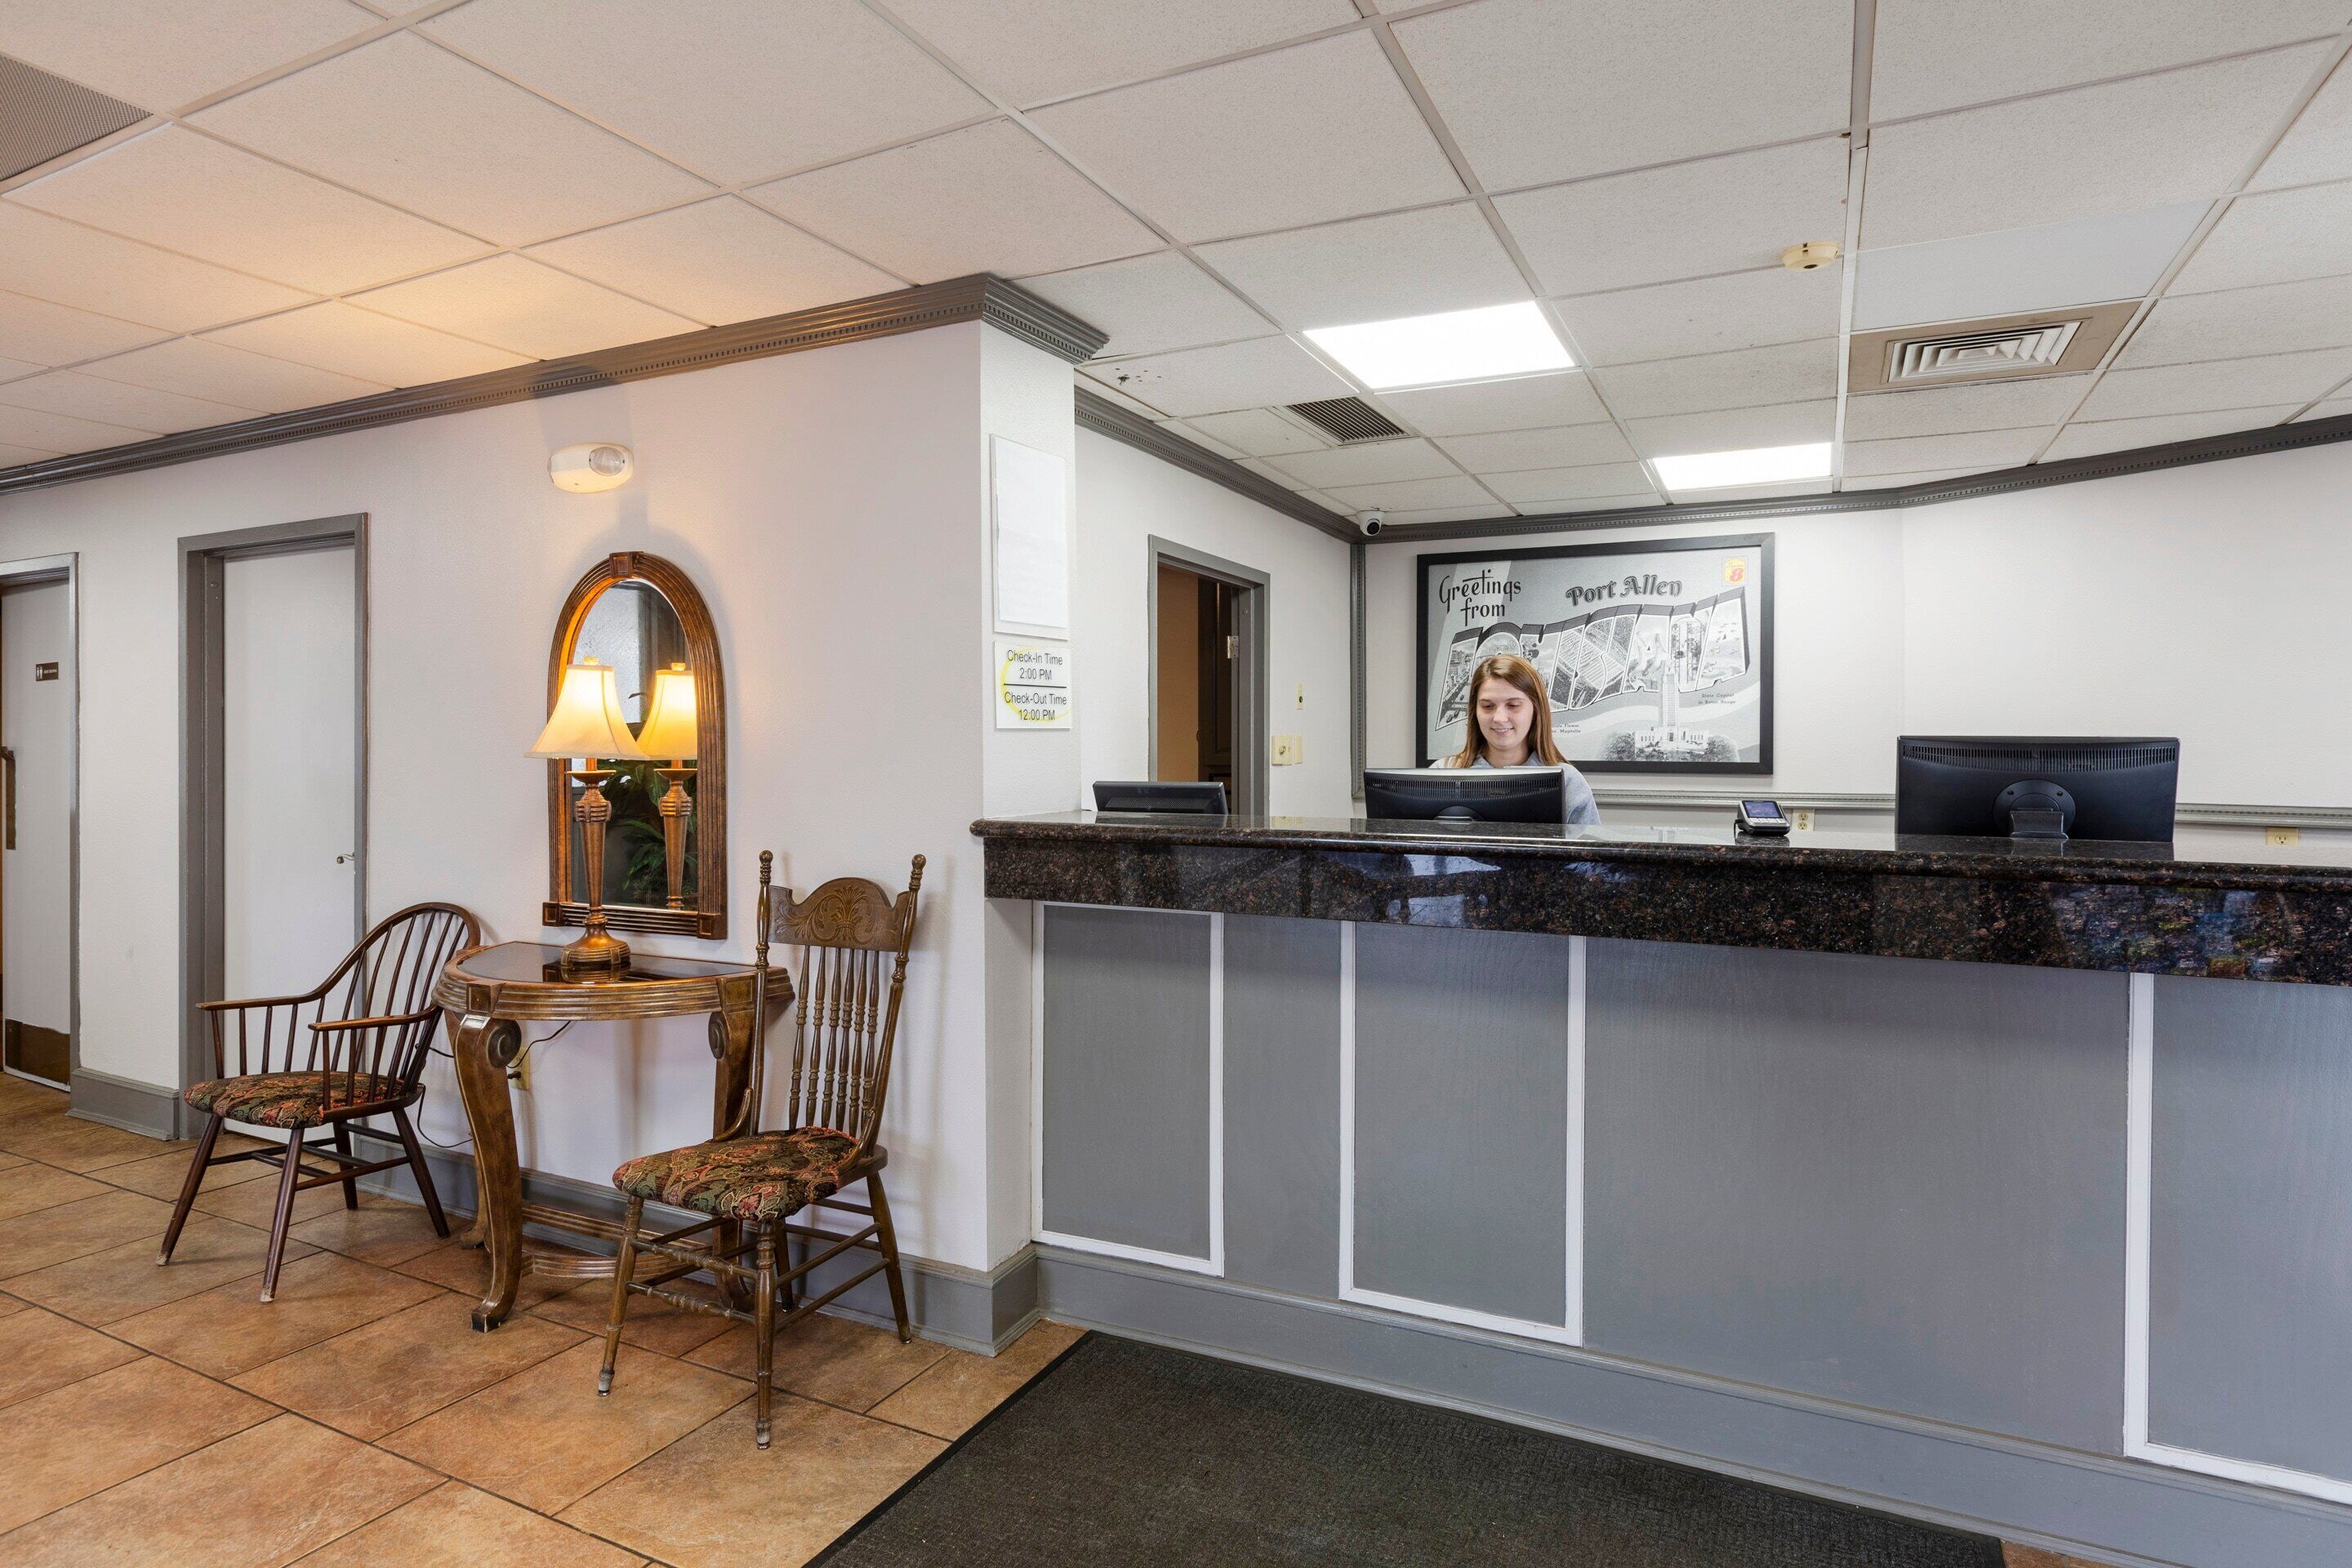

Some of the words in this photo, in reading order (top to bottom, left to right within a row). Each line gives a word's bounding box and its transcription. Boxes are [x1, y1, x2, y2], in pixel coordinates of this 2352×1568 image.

[1439, 568, 1521, 614] Greetings
[1565, 580, 1617, 607] Port
[1619, 574, 1682, 598] Allen
[1460, 597, 1505, 626] from
[1007, 649, 1042, 663] Check-In
[1045, 653, 1062, 666] Time
[1020, 667, 1037, 679] 2:00
[1039, 669, 1052, 679] PM
[1004, 691, 1047, 705] Check-Out
[1049, 693, 1067, 706] Time
[1018, 709, 1040, 720] 12:00
[1042, 710, 1055, 720] PM
